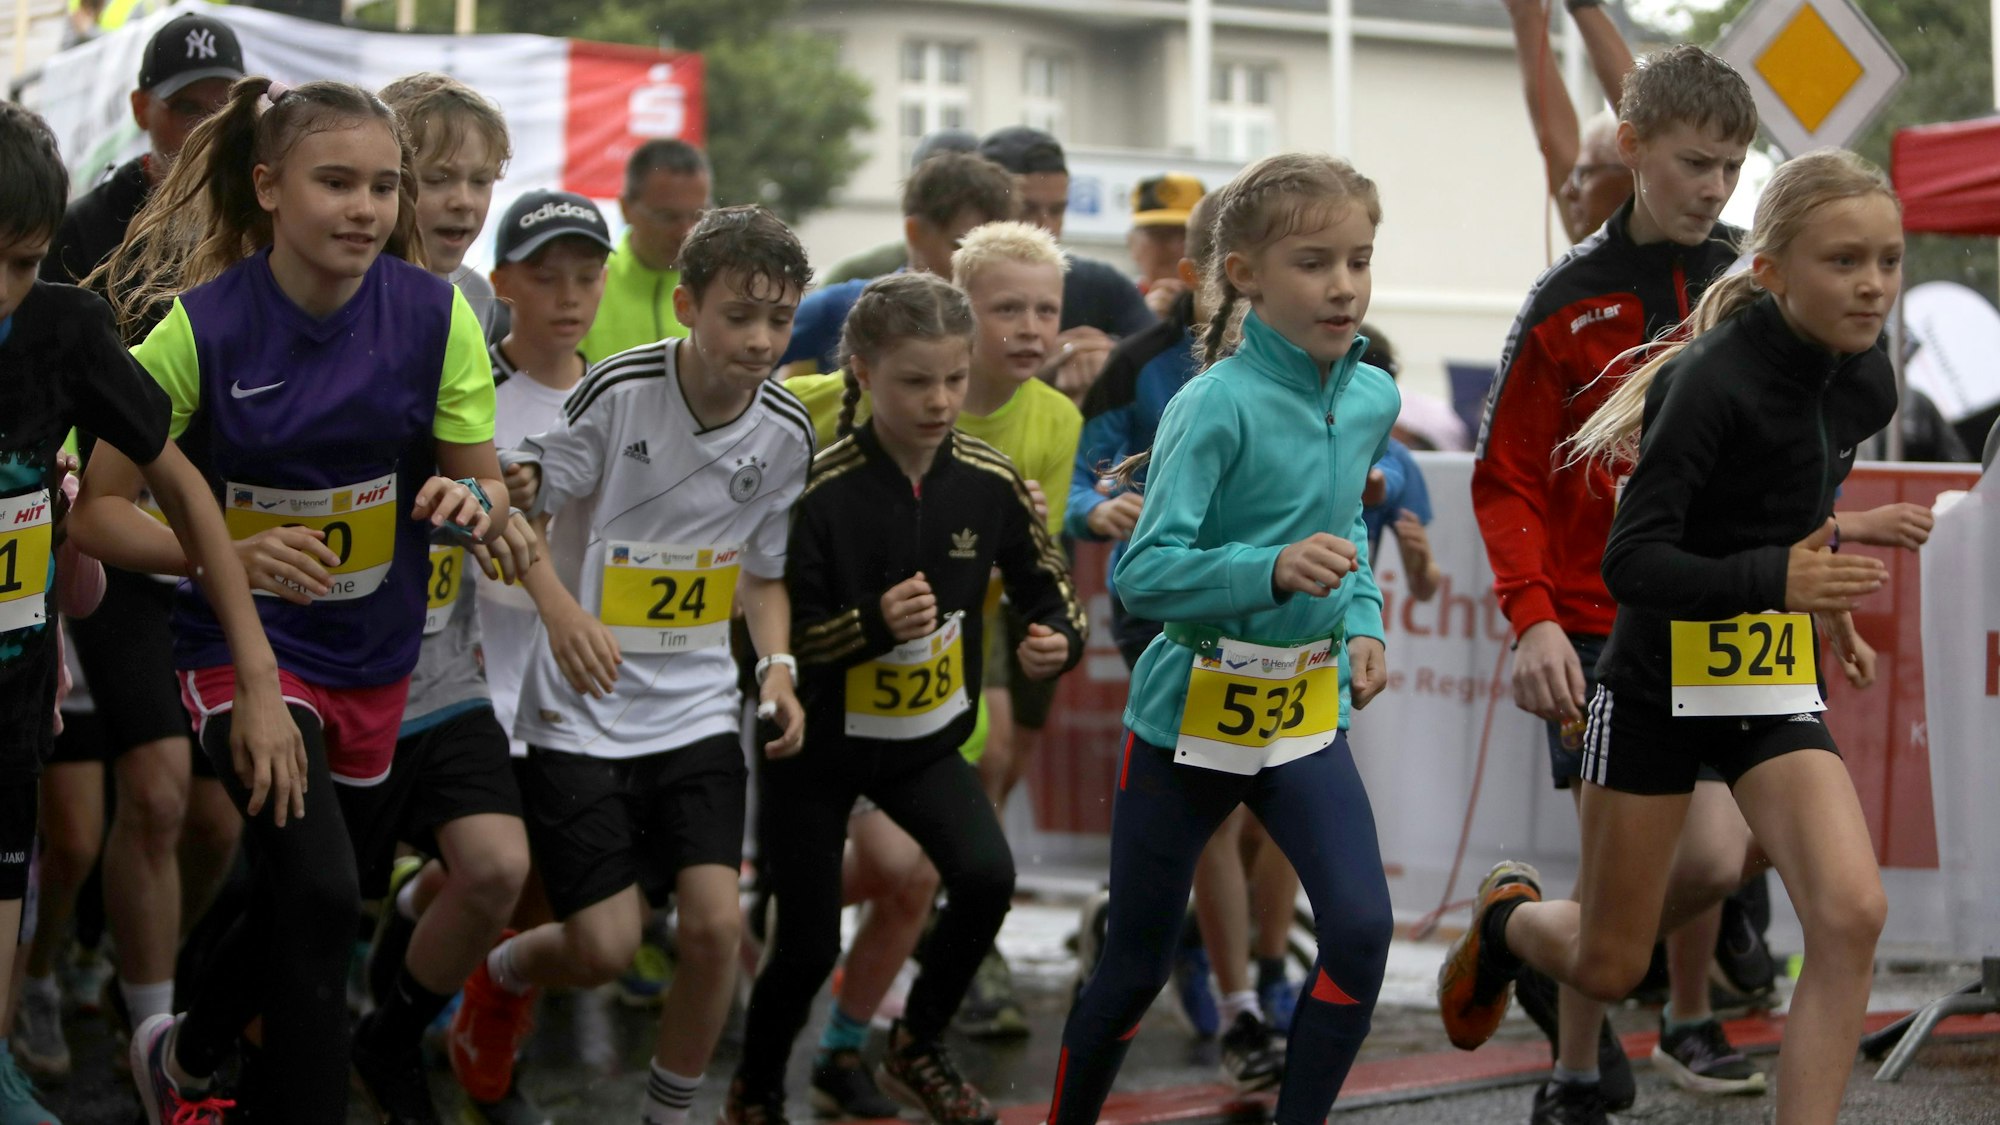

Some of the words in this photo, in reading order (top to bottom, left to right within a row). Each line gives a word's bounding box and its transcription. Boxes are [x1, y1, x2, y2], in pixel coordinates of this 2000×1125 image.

[519, 202, 598, 230] adidas
[1570, 303, 1621, 335] saller
[299, 497, 328, 507] Hennef
[356, 486, 389, 506] HIT
[14, 505, 46, 524] HIT
[713, 550, 738, 564] HIT
[647, 576, 706, 620] 24
[659, 631, 687, 647] Tim
[1708, 622, 1796, 677] 524
[1271, 658, 1297, 669] Hennef
[874, 655, 951, 710] 528
[1217, 679, 1308, 739] 533
[3, 851, 25, 863] JAKO
